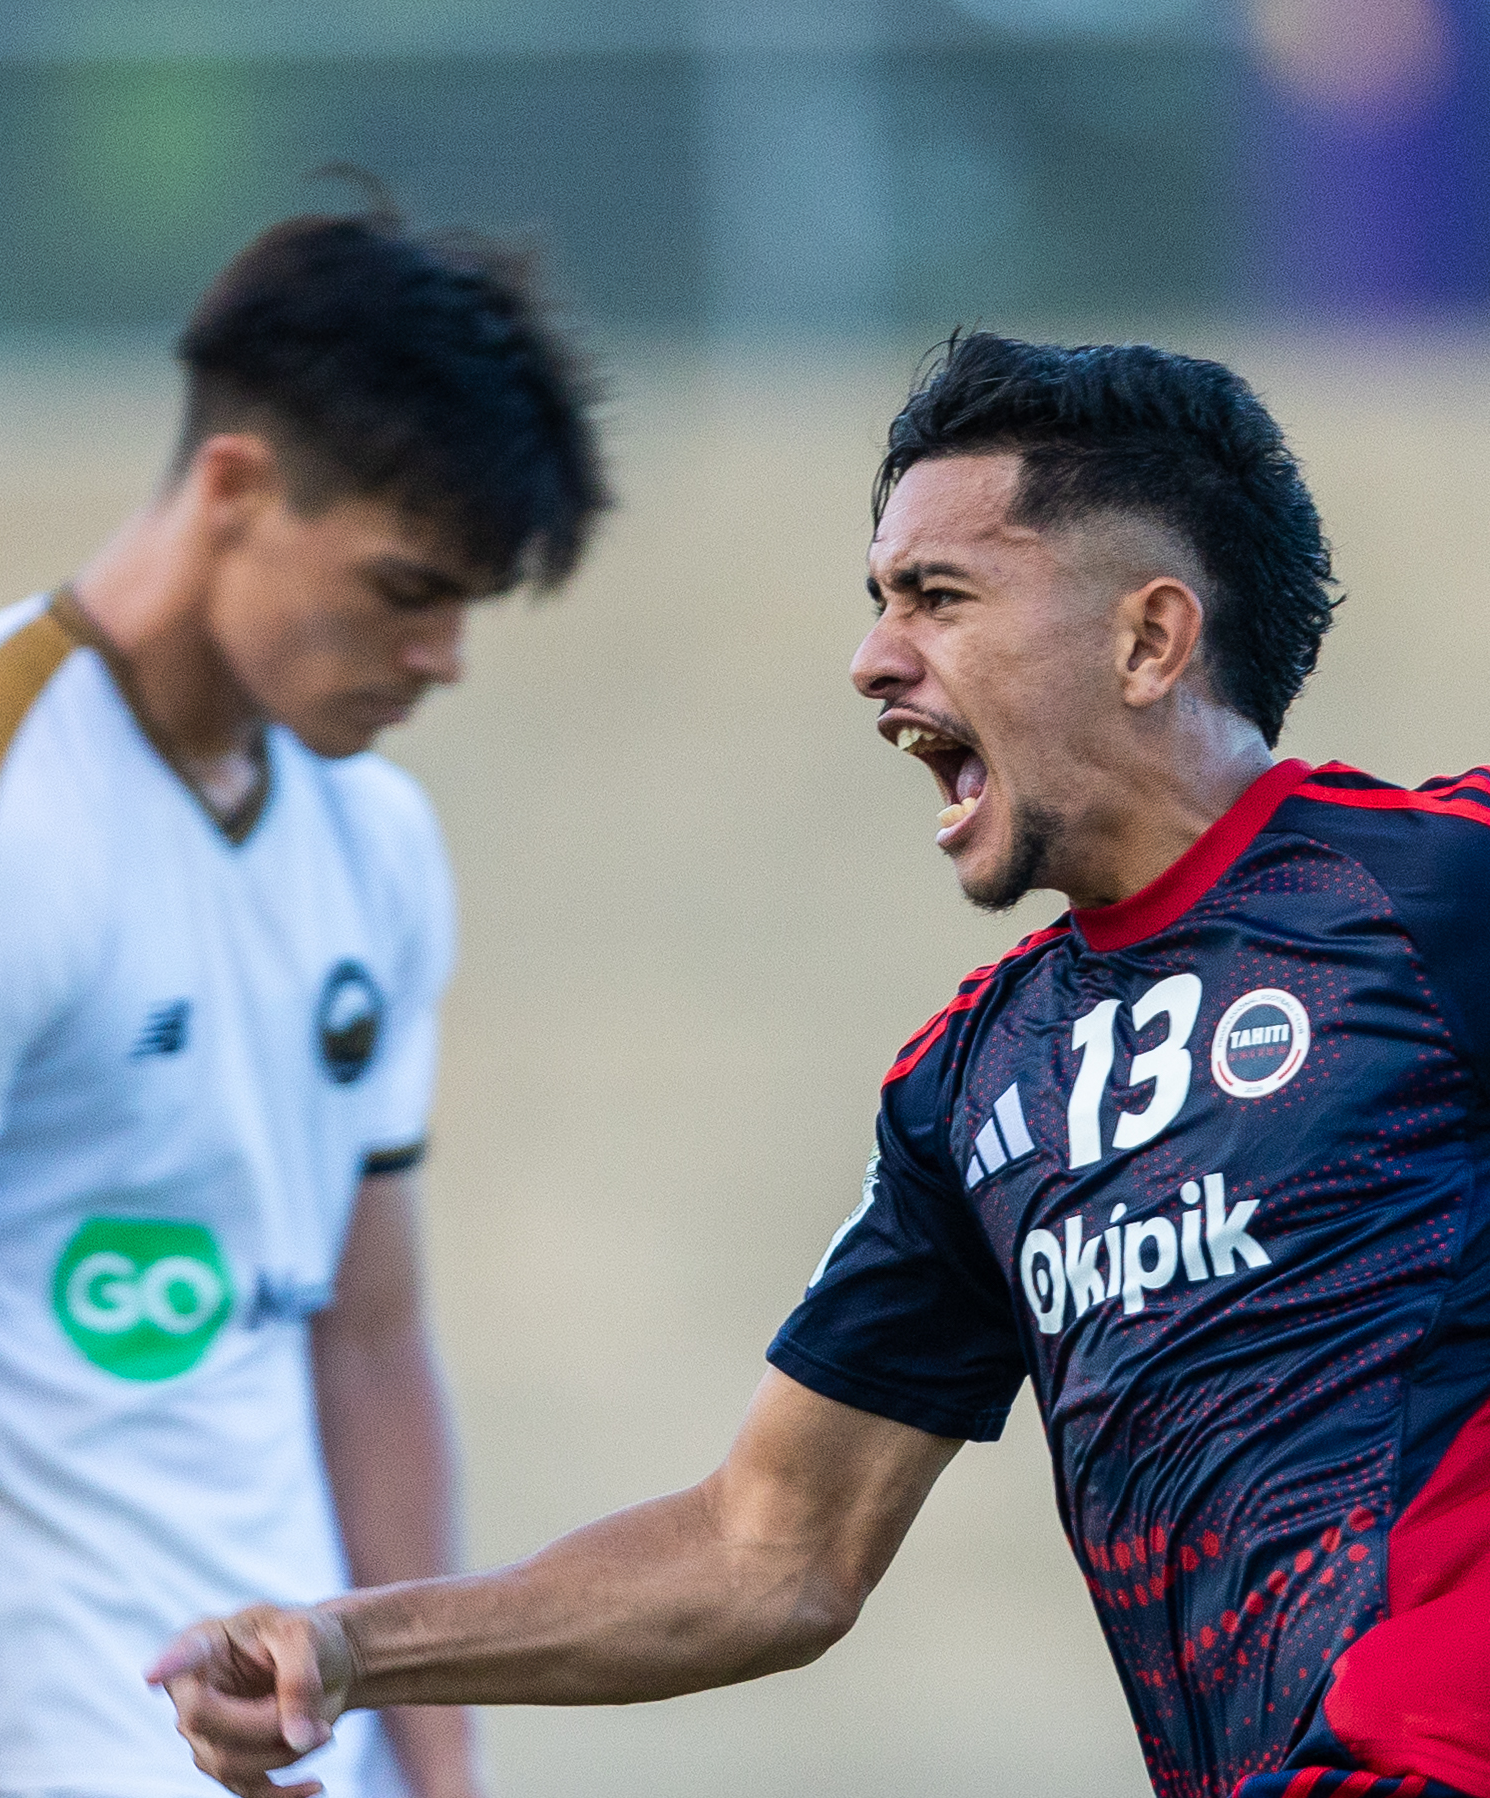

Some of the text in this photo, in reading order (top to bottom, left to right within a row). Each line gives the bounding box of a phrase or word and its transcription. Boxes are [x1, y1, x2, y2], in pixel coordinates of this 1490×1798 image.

[1067, 972, 1203, 1170] 13
[1229, 1023, 1290, 1049] TAHITI
[65, 1251, 224, 1335] GO
[1020, 1172, 1273, 1335] Okipik
